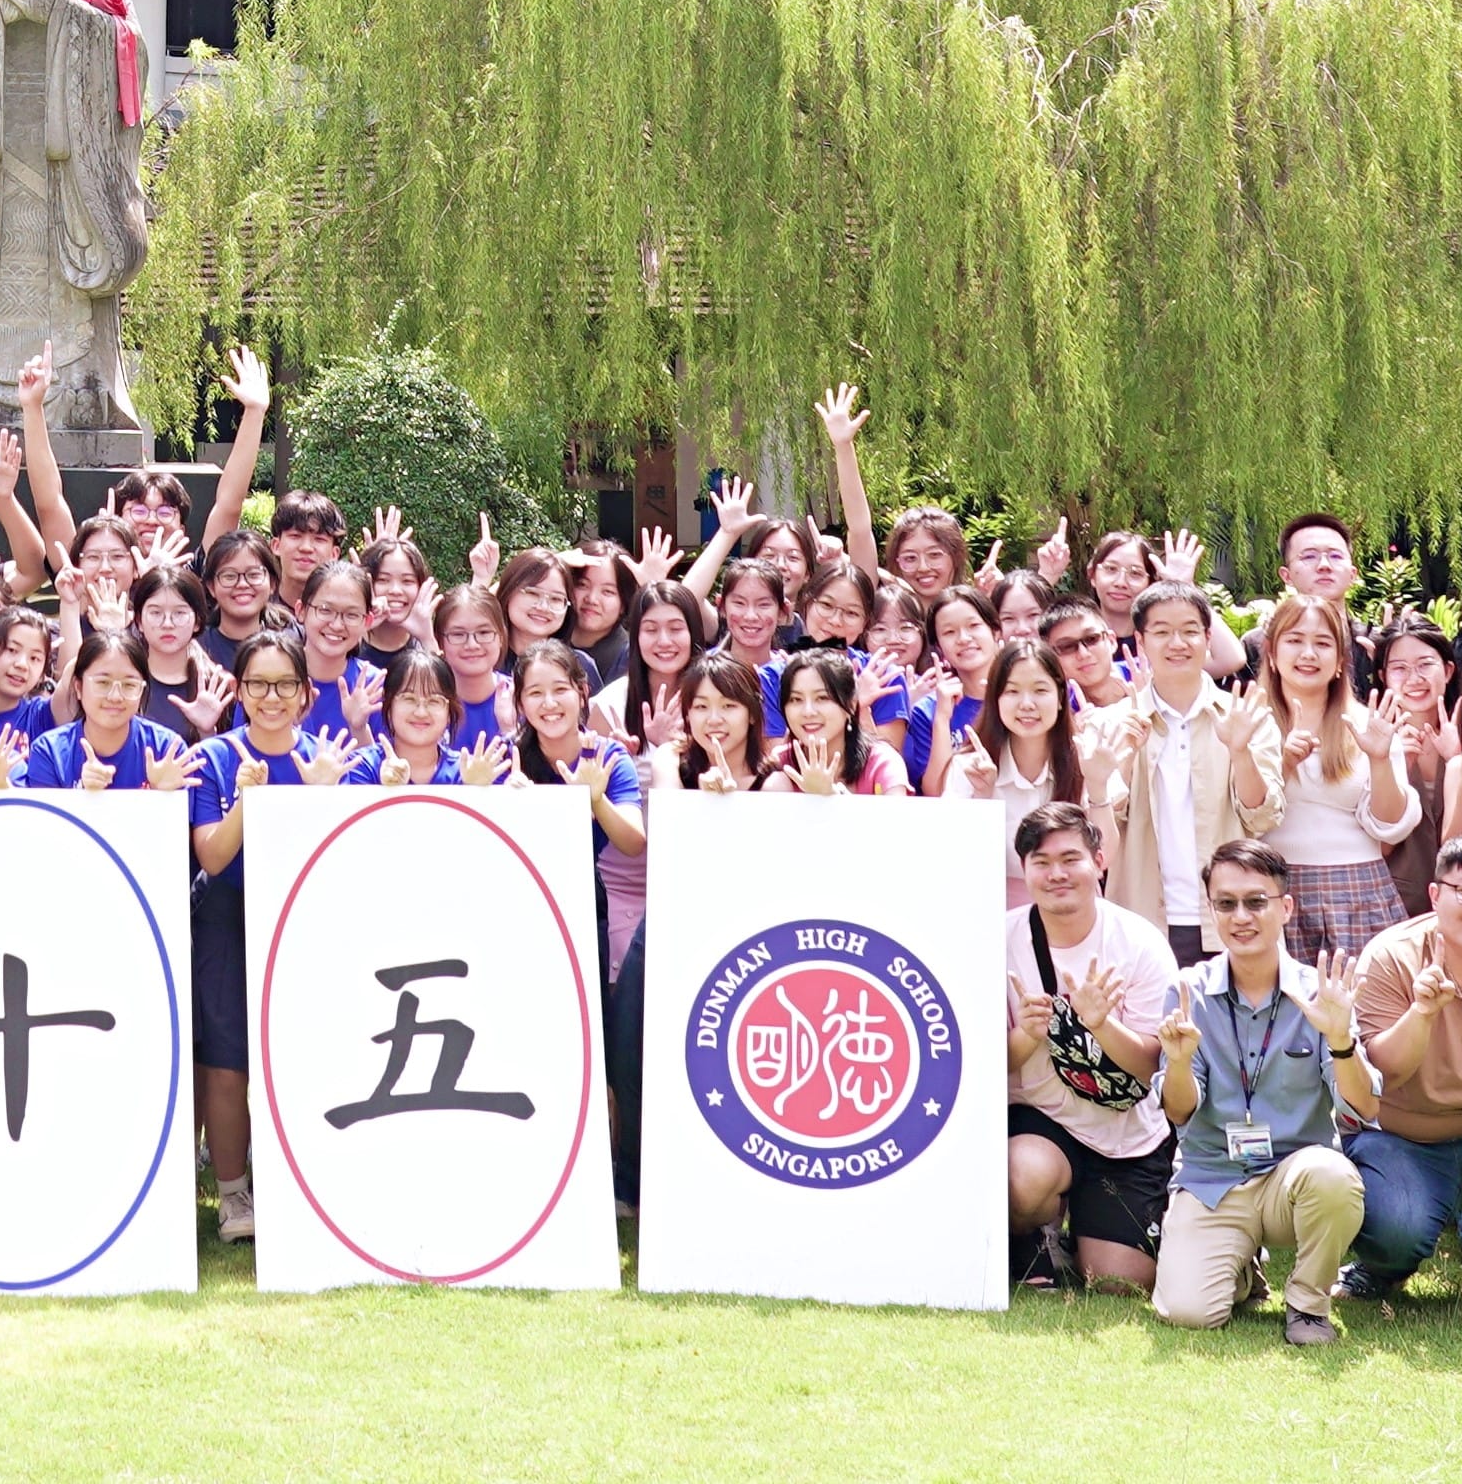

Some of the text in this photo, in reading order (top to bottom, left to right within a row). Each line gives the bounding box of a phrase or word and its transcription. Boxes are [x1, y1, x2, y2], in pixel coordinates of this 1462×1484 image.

[324, 959, 535, 1130] 五
[696, 927, 953, 1061] DUNMAN HIGH SCHOOL
[741, 1132, 903, 1180] SINGAPORE
